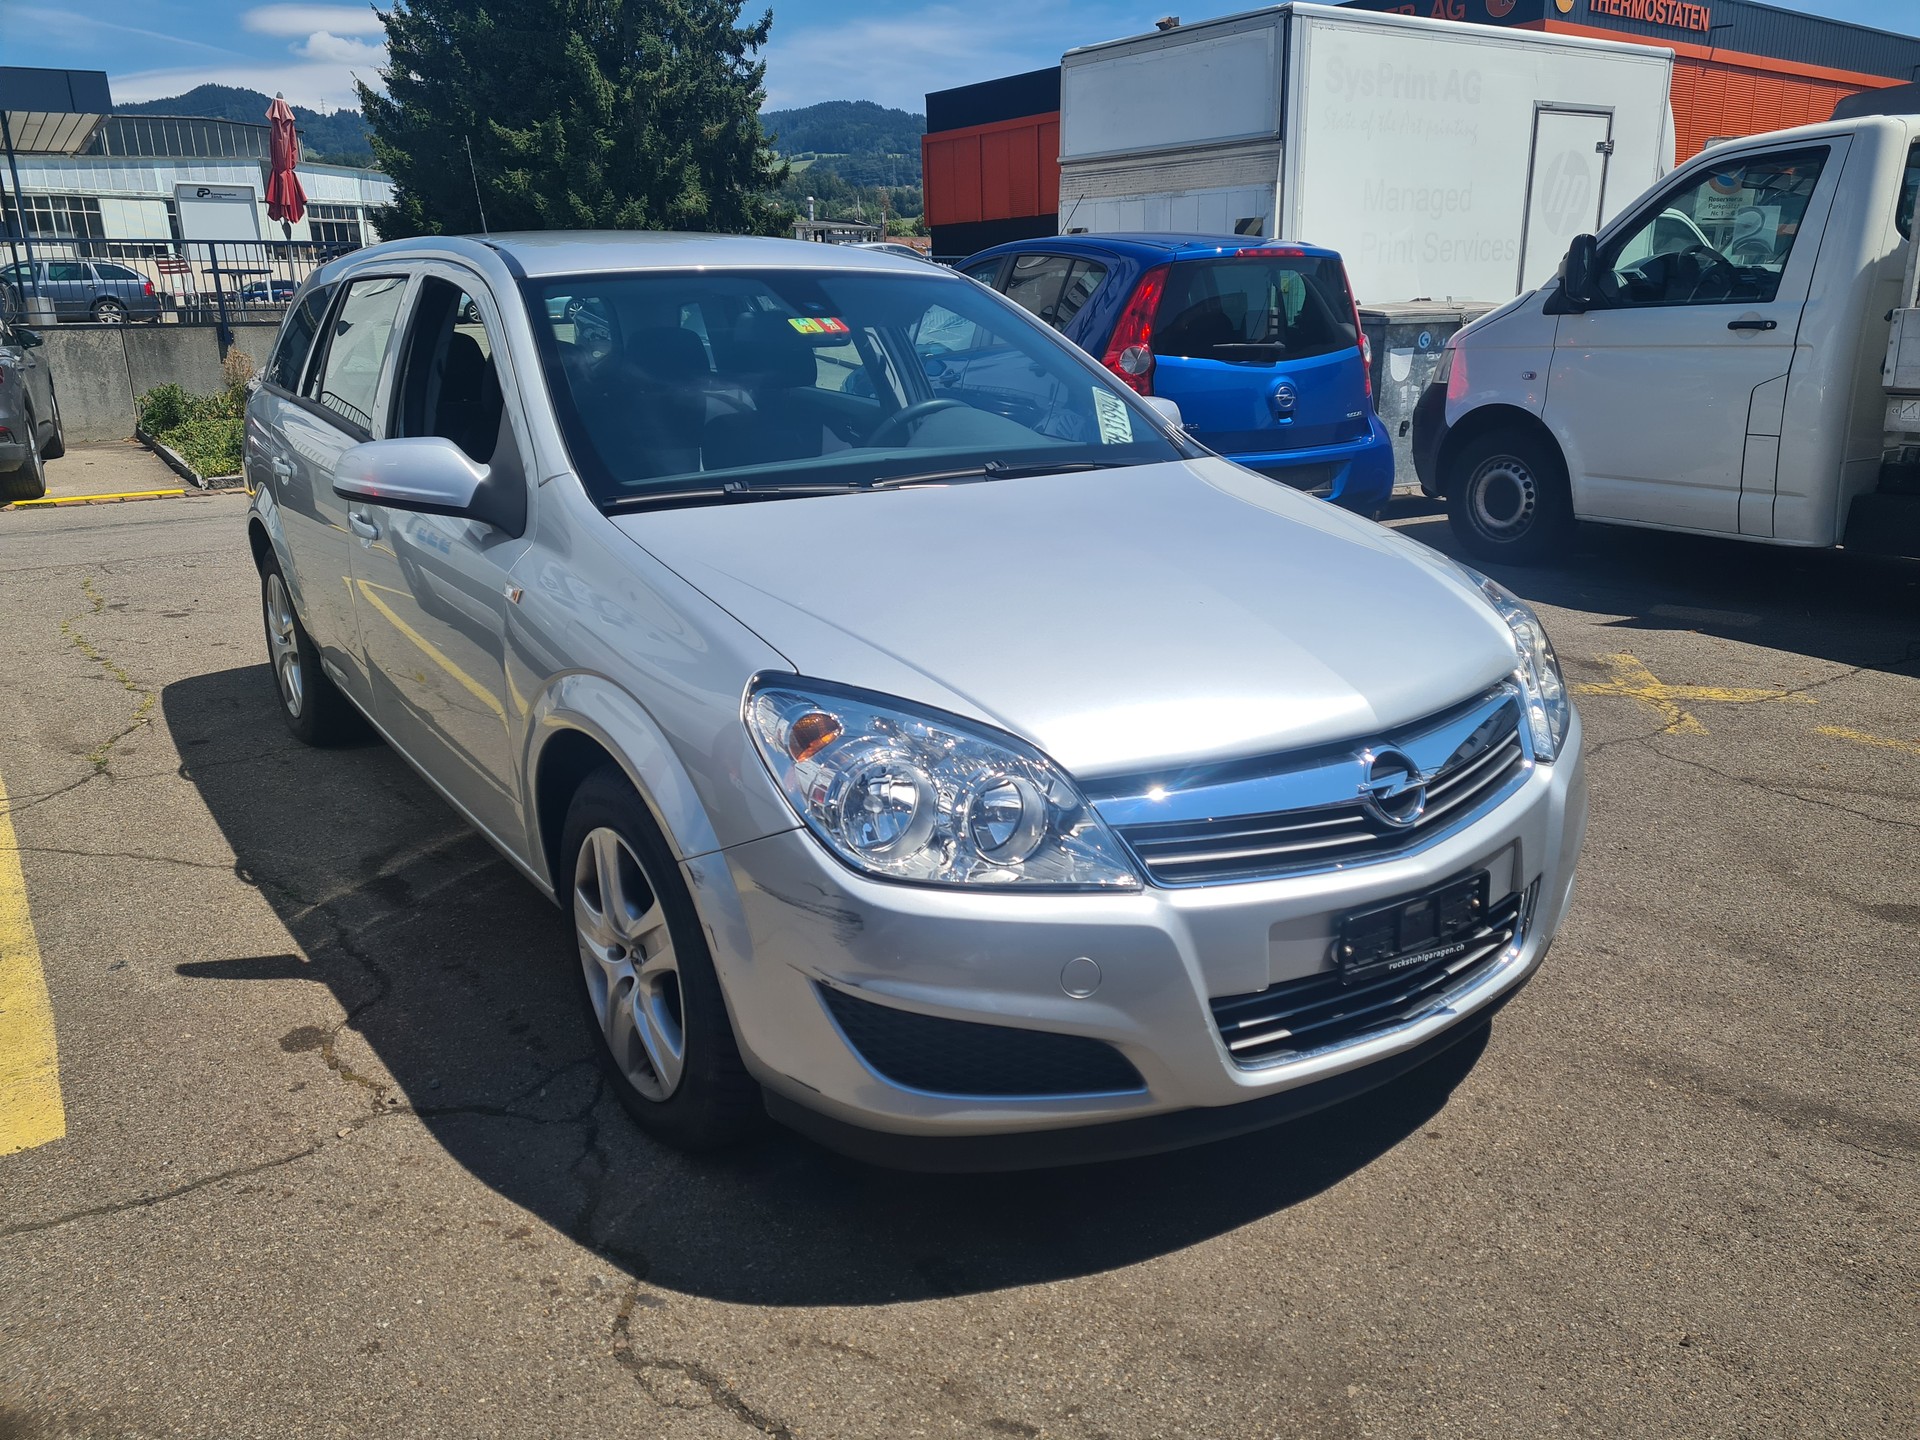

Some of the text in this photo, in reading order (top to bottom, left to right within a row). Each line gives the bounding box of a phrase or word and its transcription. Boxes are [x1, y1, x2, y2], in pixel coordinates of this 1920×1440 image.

[1430, 0, 1466, 20] AG
[1588, 0, 1710, 32] THERMOSTATEN
[1324, 55, 1482, 104] SysPrint AG
[1362, 178, 1474, 221] Managed
[1360, 230, 1516, 265] Print Services
[1389, 943, 1465, 970] ruckstuhlgaragen.ch
